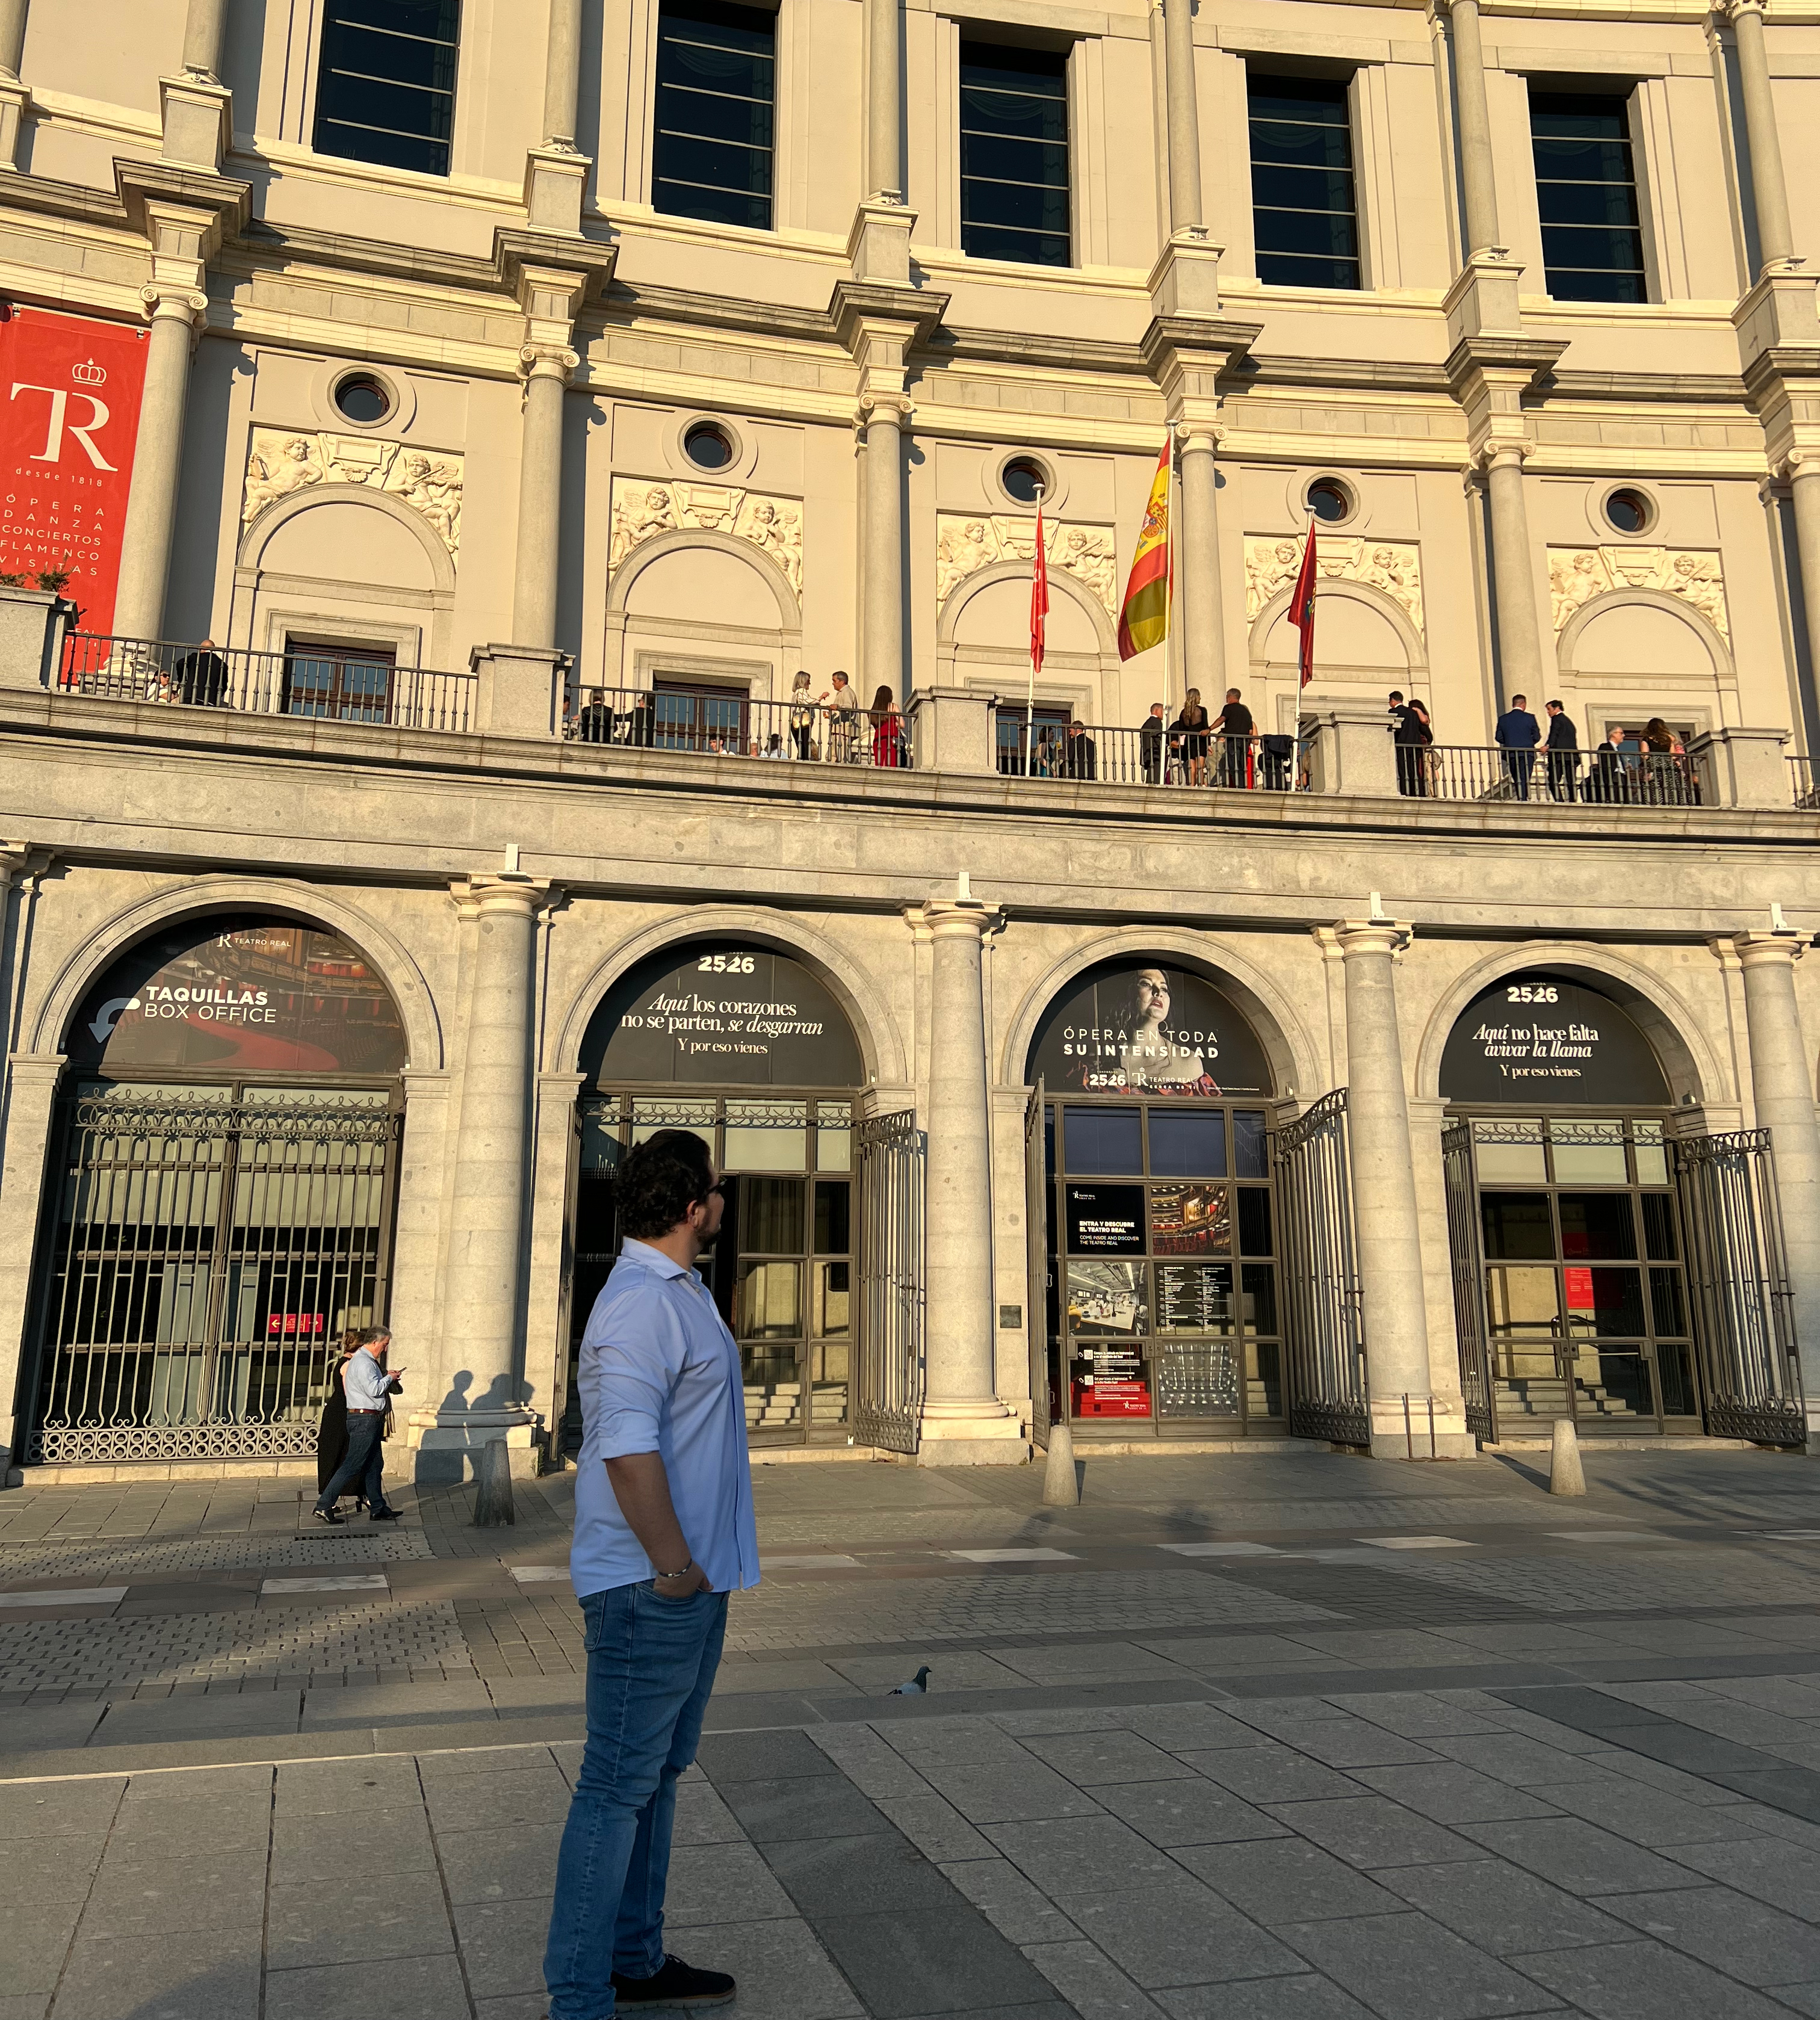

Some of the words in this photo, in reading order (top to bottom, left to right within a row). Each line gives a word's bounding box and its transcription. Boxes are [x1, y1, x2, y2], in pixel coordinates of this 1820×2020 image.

[10, 382, 118, 472] TR
[16, 468, 60, 481] desde
[71, 475, 102, 487] 1818
[6, 493, 104, 516] ÓPERA
[4, 510, 102, 531] DANZA
[2, 525, 101, 546] CONCIERTOS
[0, 540, 99, 561] FLAMENCO
[146, 986, 268, 1005] TAQUILLAS
[647, 993, 692, 1015] Aquí
[692, 993, 715, 1012] los
[719, 1000, 797, 1016] corazones
[144, 1003, 190, 1019] BOX
[198, 1005, 277, 1023] OFFICE
[621, 1015, 643, 1028] no
[646, 1016, 664, 1028] se
[667, 1015, 724, 1034] parten,
[728, 1019, 743, 1032] se
[746, 1015, 823, 1038] desgarran
[1063, 1026, 1127, 1041] ÓPERA
[1136, 1030, 1158, 1041] EN
[1166, 1031, 1218, 1043] TODA
[1472, 1024, 1509, 1044] Aquí
[1511, 1028, 1531, 1040] no
[1532, 1024, 1567, 1040] hace
[1569, 1024, 1599, 1041] falta
[678, 1038, 689, 1051] Y
[690, 1042, 711, 1054] por
[713, 1043, 731, 1052] eso
[734, 1040, 768, 1054] vienes
[1063, 1044, 1087, 1055] SU
[1097, 1045, 1219, 1058] INTENSIDAD
[1484, 1041, 1530, 1057] avivar
[1532, 1041, 1547, 1057] la
[1550, 1041, 1593, 1057] llama
[1500, 1064, 1509, 1076] Y
[1512, 1067, 1530, 1079] por
[1550, 1066, 1581, 1076] vienes
